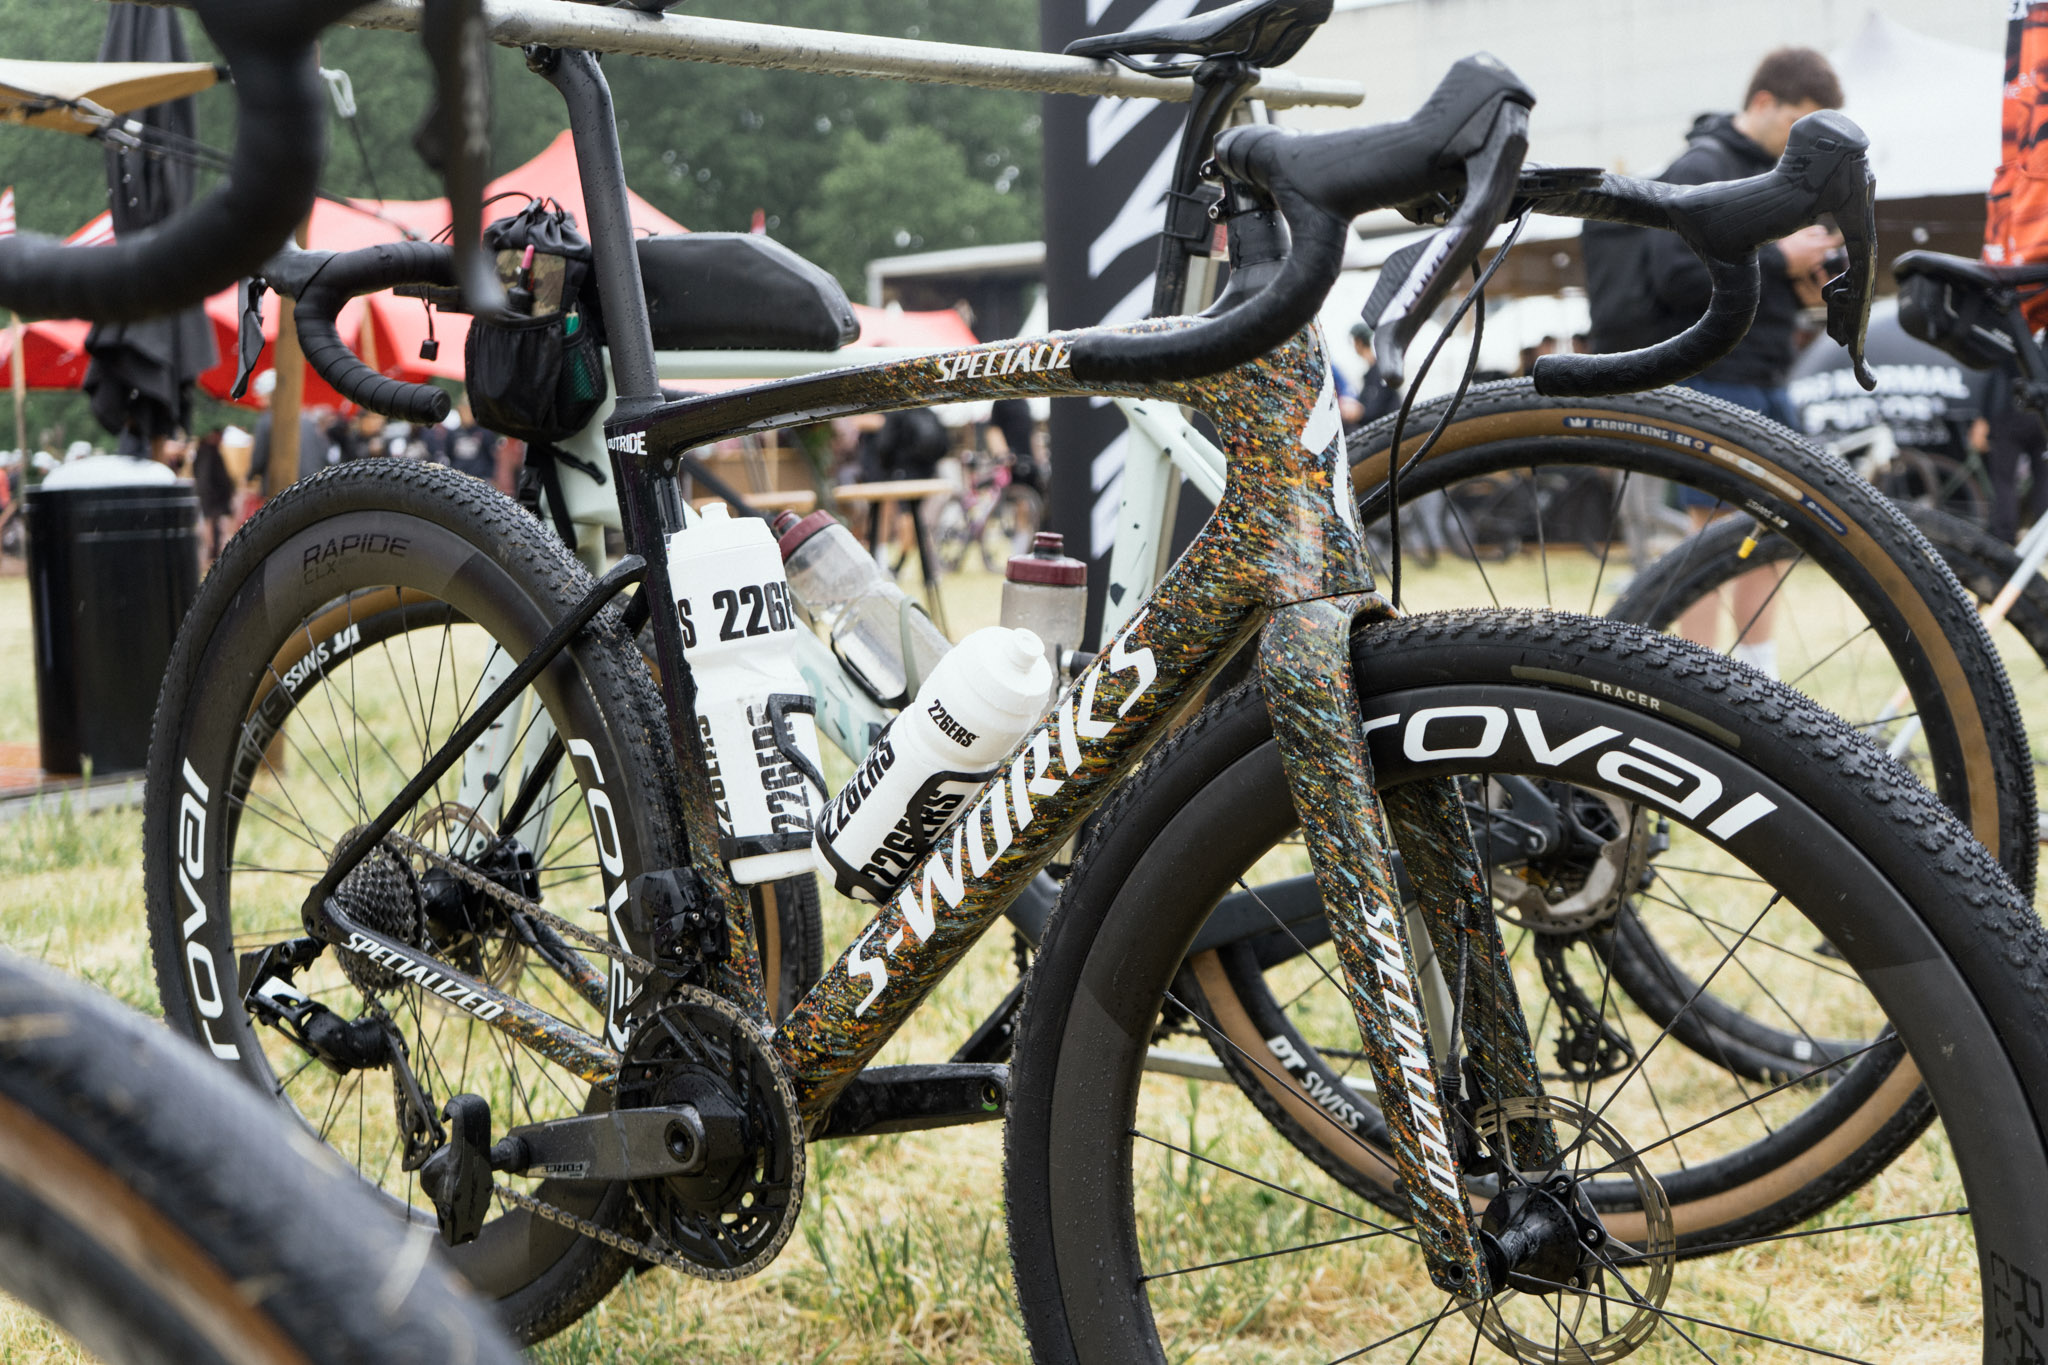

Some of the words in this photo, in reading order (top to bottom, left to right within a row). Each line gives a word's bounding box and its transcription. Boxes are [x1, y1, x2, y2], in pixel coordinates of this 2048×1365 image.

[607, 431, 648, 456] OUTRIDE
[1592, 419, 1668, 440] GRAVELKING
[1675, 434, 1692, 447] SK
[303, 533, 411, 572] RAPIDE
[303, 560, 337, 585] CLX
[334, 623, 362, 654] DT
[283, 642, 331, 694] SWISS
[1590, 680, 1660, 711] TRACER
[927, 698, 979, 748] 226ERS
[848, 607, 1157, 1018] S-WORKS
[178, 756, 241, 1061] roval
[341, 932, 505, 1022] SPECIALIZED
[1358, 891, 1460, 1200] SPECIALIZED
[1266, 1034, 1308, 1070] DT
[1299, 1071, 1366, 1131] SWISS
